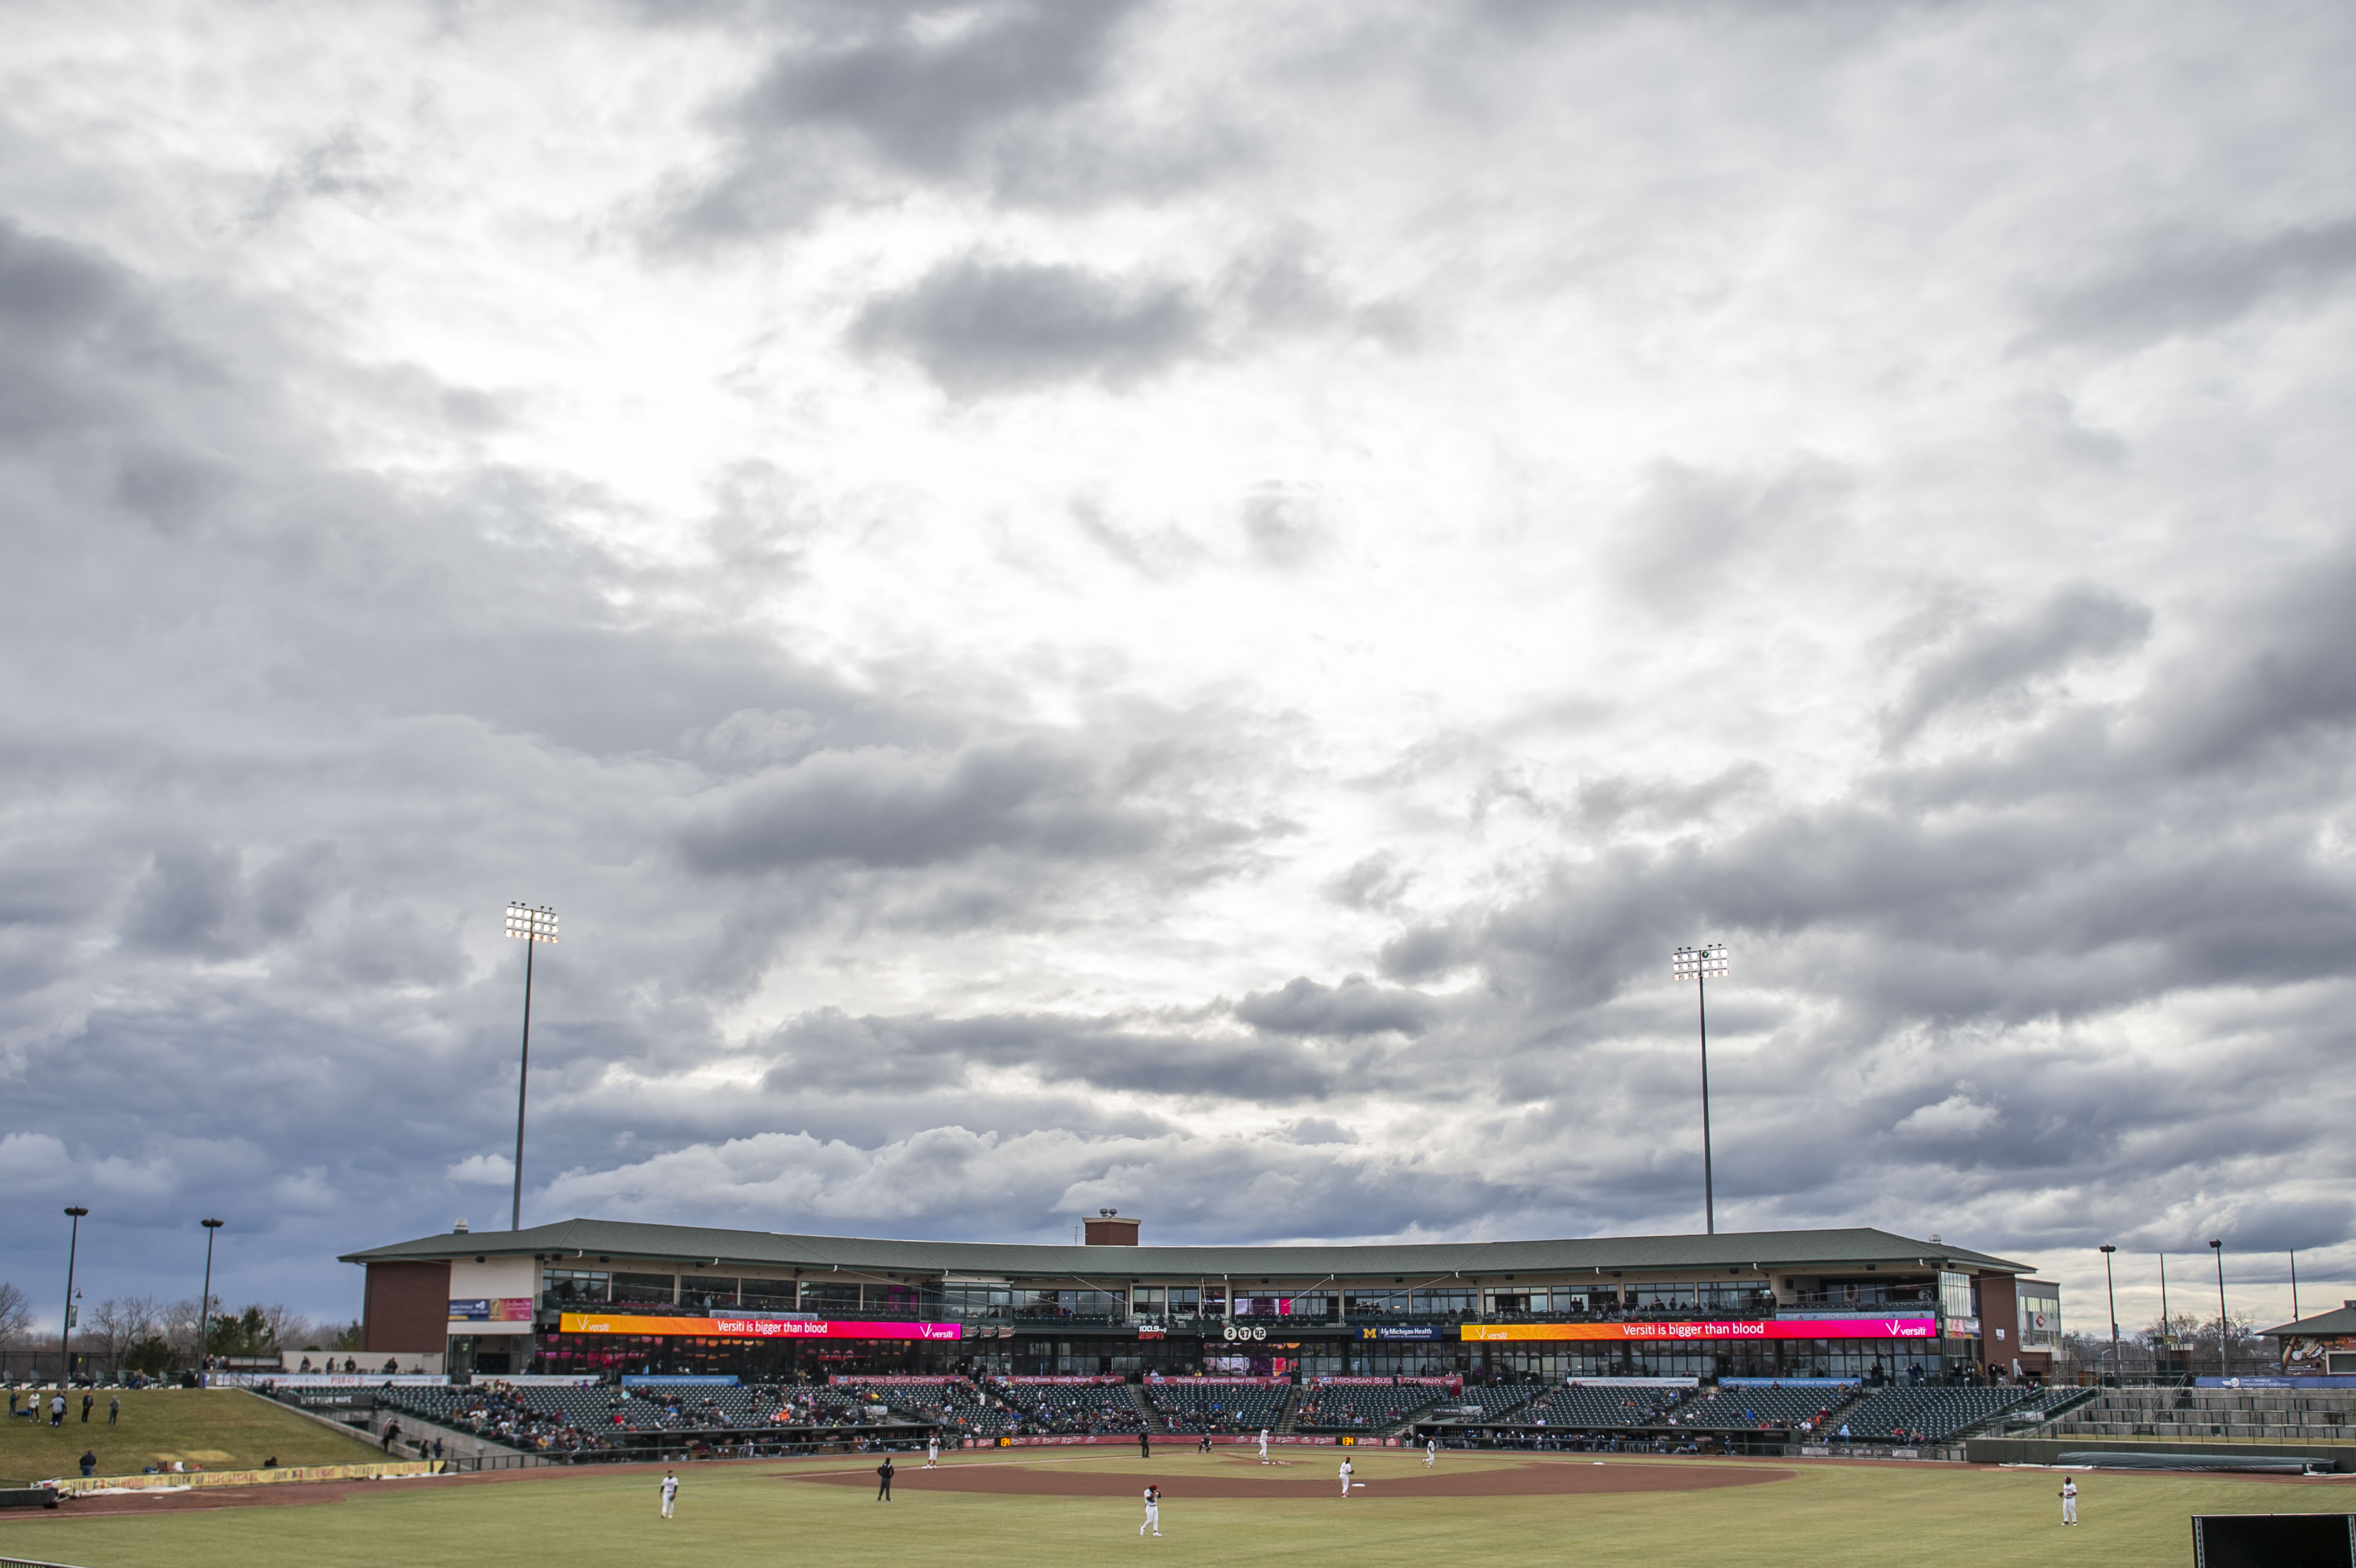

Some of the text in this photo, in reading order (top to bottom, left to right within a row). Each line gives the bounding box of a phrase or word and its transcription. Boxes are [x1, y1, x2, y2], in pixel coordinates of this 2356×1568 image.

[717, 1321, 827, 1335] Versiti is bigger than blood
[1622, 1322, 1764, 1337] Versiti is bigger than blood
[1900, 1327, 1927, 1335] versiti
[932, 1330, 954, 1339] versiti
[1227, 1329, 1233, 1338] 2
[1240, 1329, 1249, 1338] 47
[1254, 1329, 1264, 1338] 42
[1363, 1328, 1377, 1339] M
[1487, 1331, 1508, 1339] versiti
